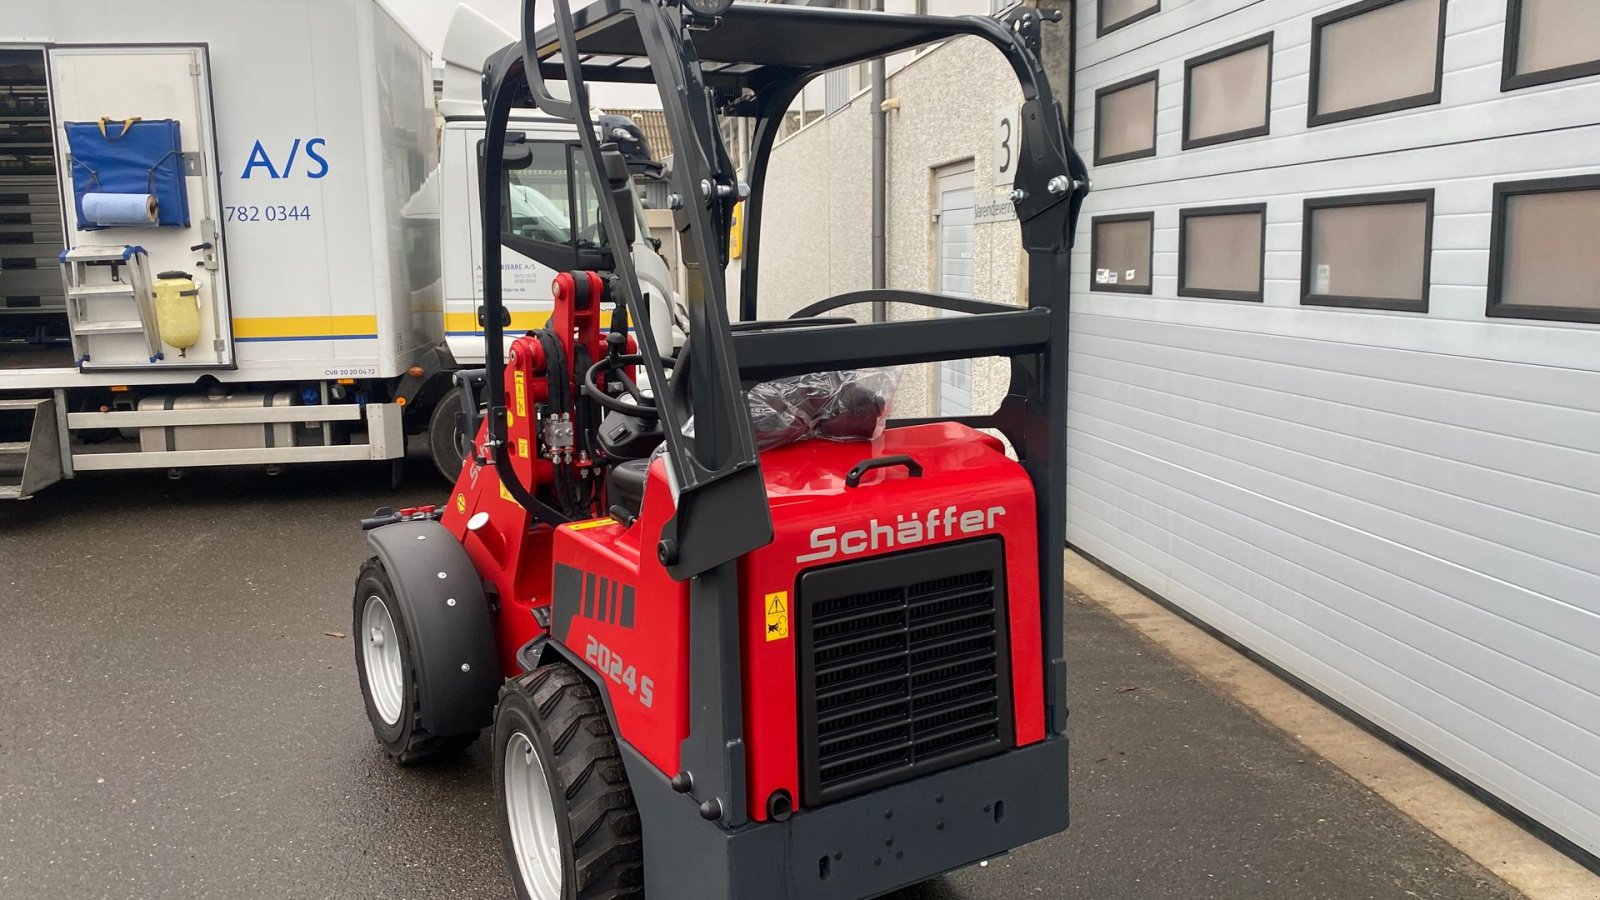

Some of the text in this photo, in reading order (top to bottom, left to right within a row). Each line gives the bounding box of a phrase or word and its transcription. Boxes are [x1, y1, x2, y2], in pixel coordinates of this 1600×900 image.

[240, 137, 329, 179] A/S
[999, 117, 1011, 174] 3
[265, 205, 311, 221] 0344
[796, 505, 1006, 563] Schäffer
[585, 633, 654, 708] 2024 S
